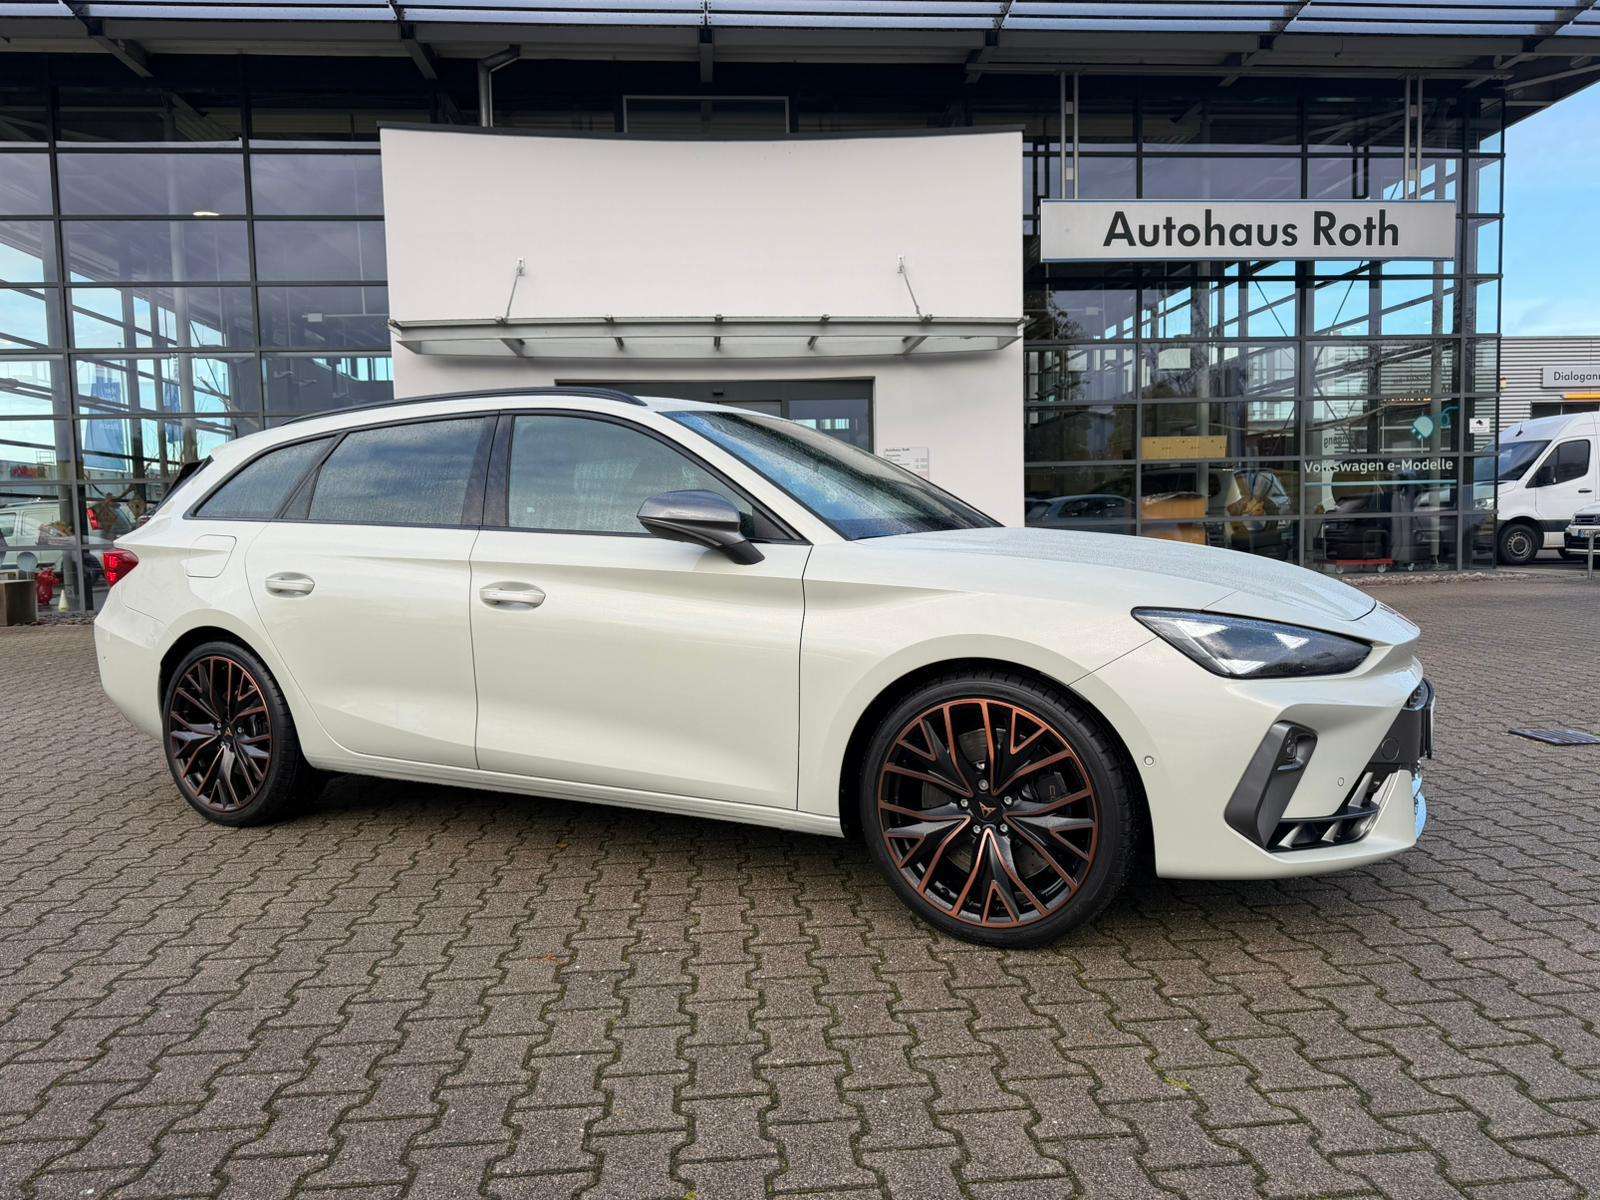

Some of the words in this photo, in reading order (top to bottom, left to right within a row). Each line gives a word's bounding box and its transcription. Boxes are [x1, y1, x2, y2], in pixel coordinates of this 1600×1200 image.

[1103, 209, 1298, 248] Autohaus
[1312, 209, 1400, 248] Roth
[1553, 370, 1600, 383] Dialogan
[1387, 459, 1454, 472] e-Modelle
